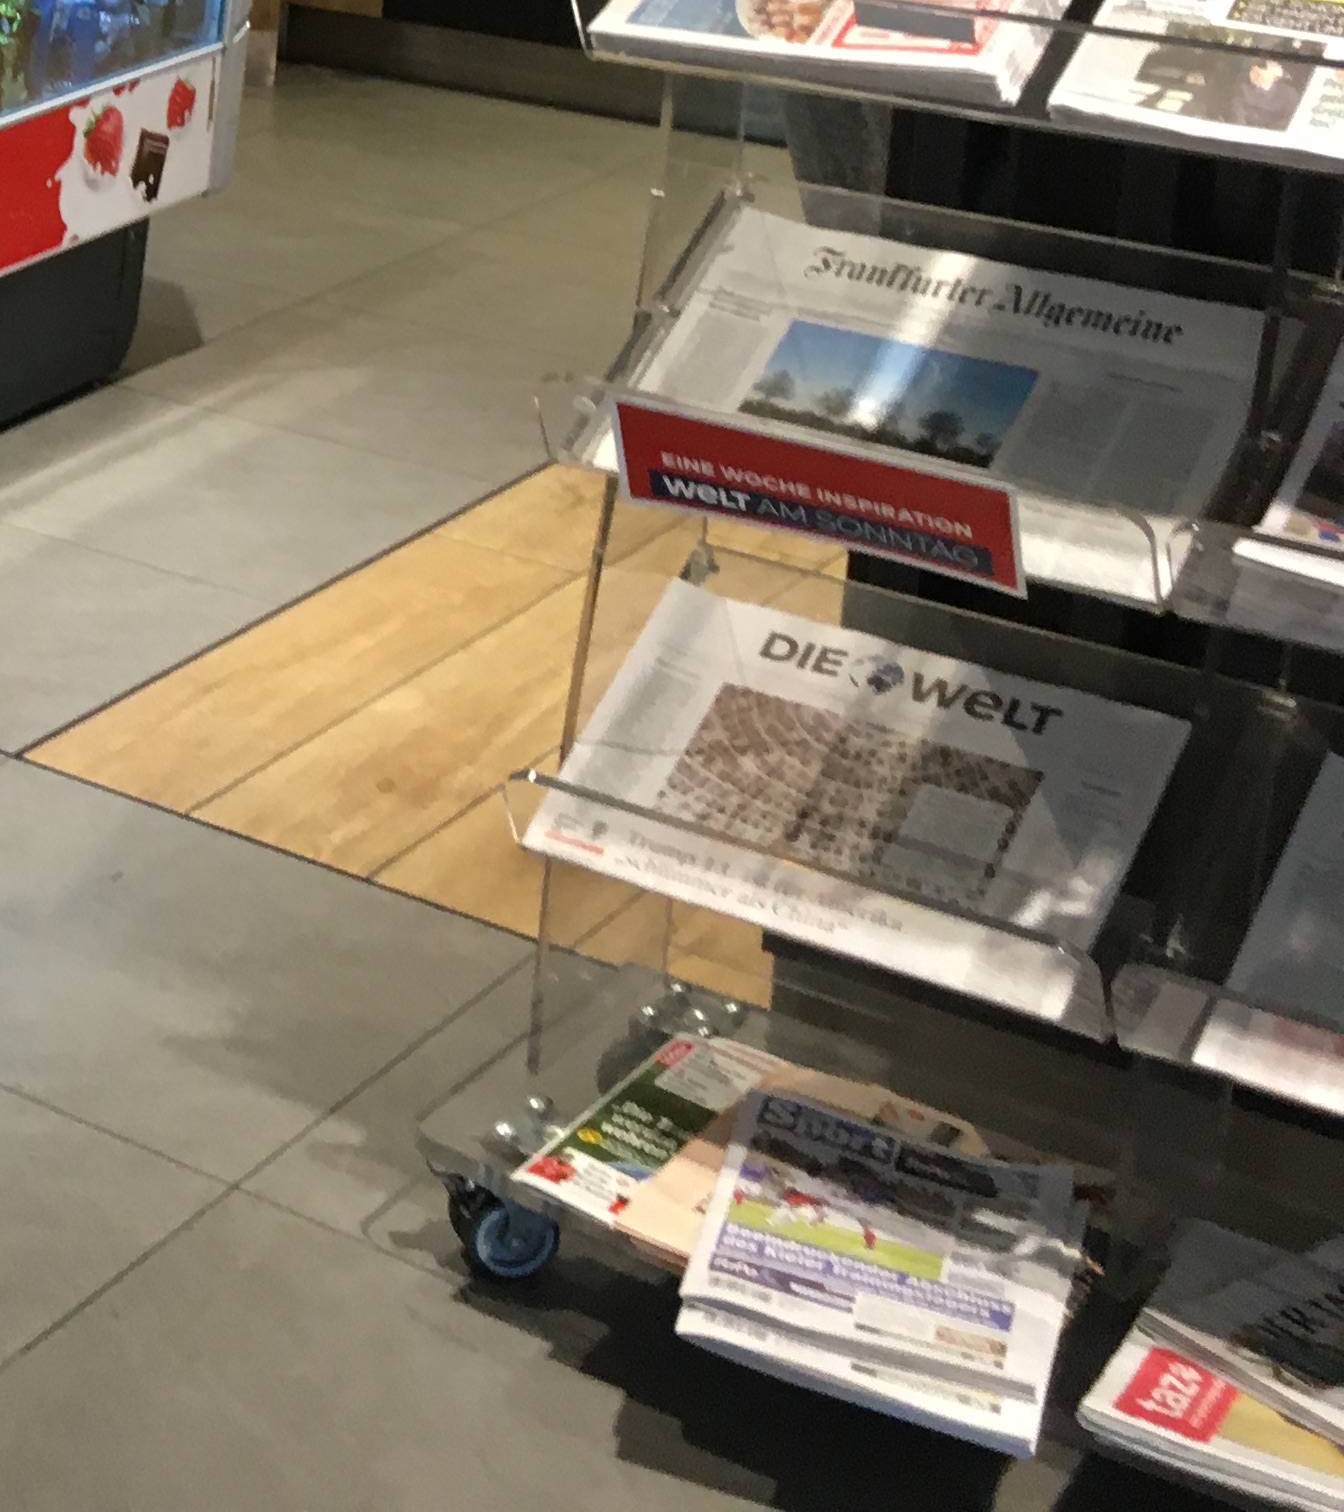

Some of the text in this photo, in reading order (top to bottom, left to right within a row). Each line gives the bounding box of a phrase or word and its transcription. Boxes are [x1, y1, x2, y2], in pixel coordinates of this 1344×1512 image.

[804, 246, 1184, 345] Frankfurter Allgemeine
[661, 450, 974, 539] EINE WOCHE INSPIRATION
[756, 498, 808, 527] AM
[815, 508, 979, 569] SONNTAG
[759, 630, 850, 678] DIE
